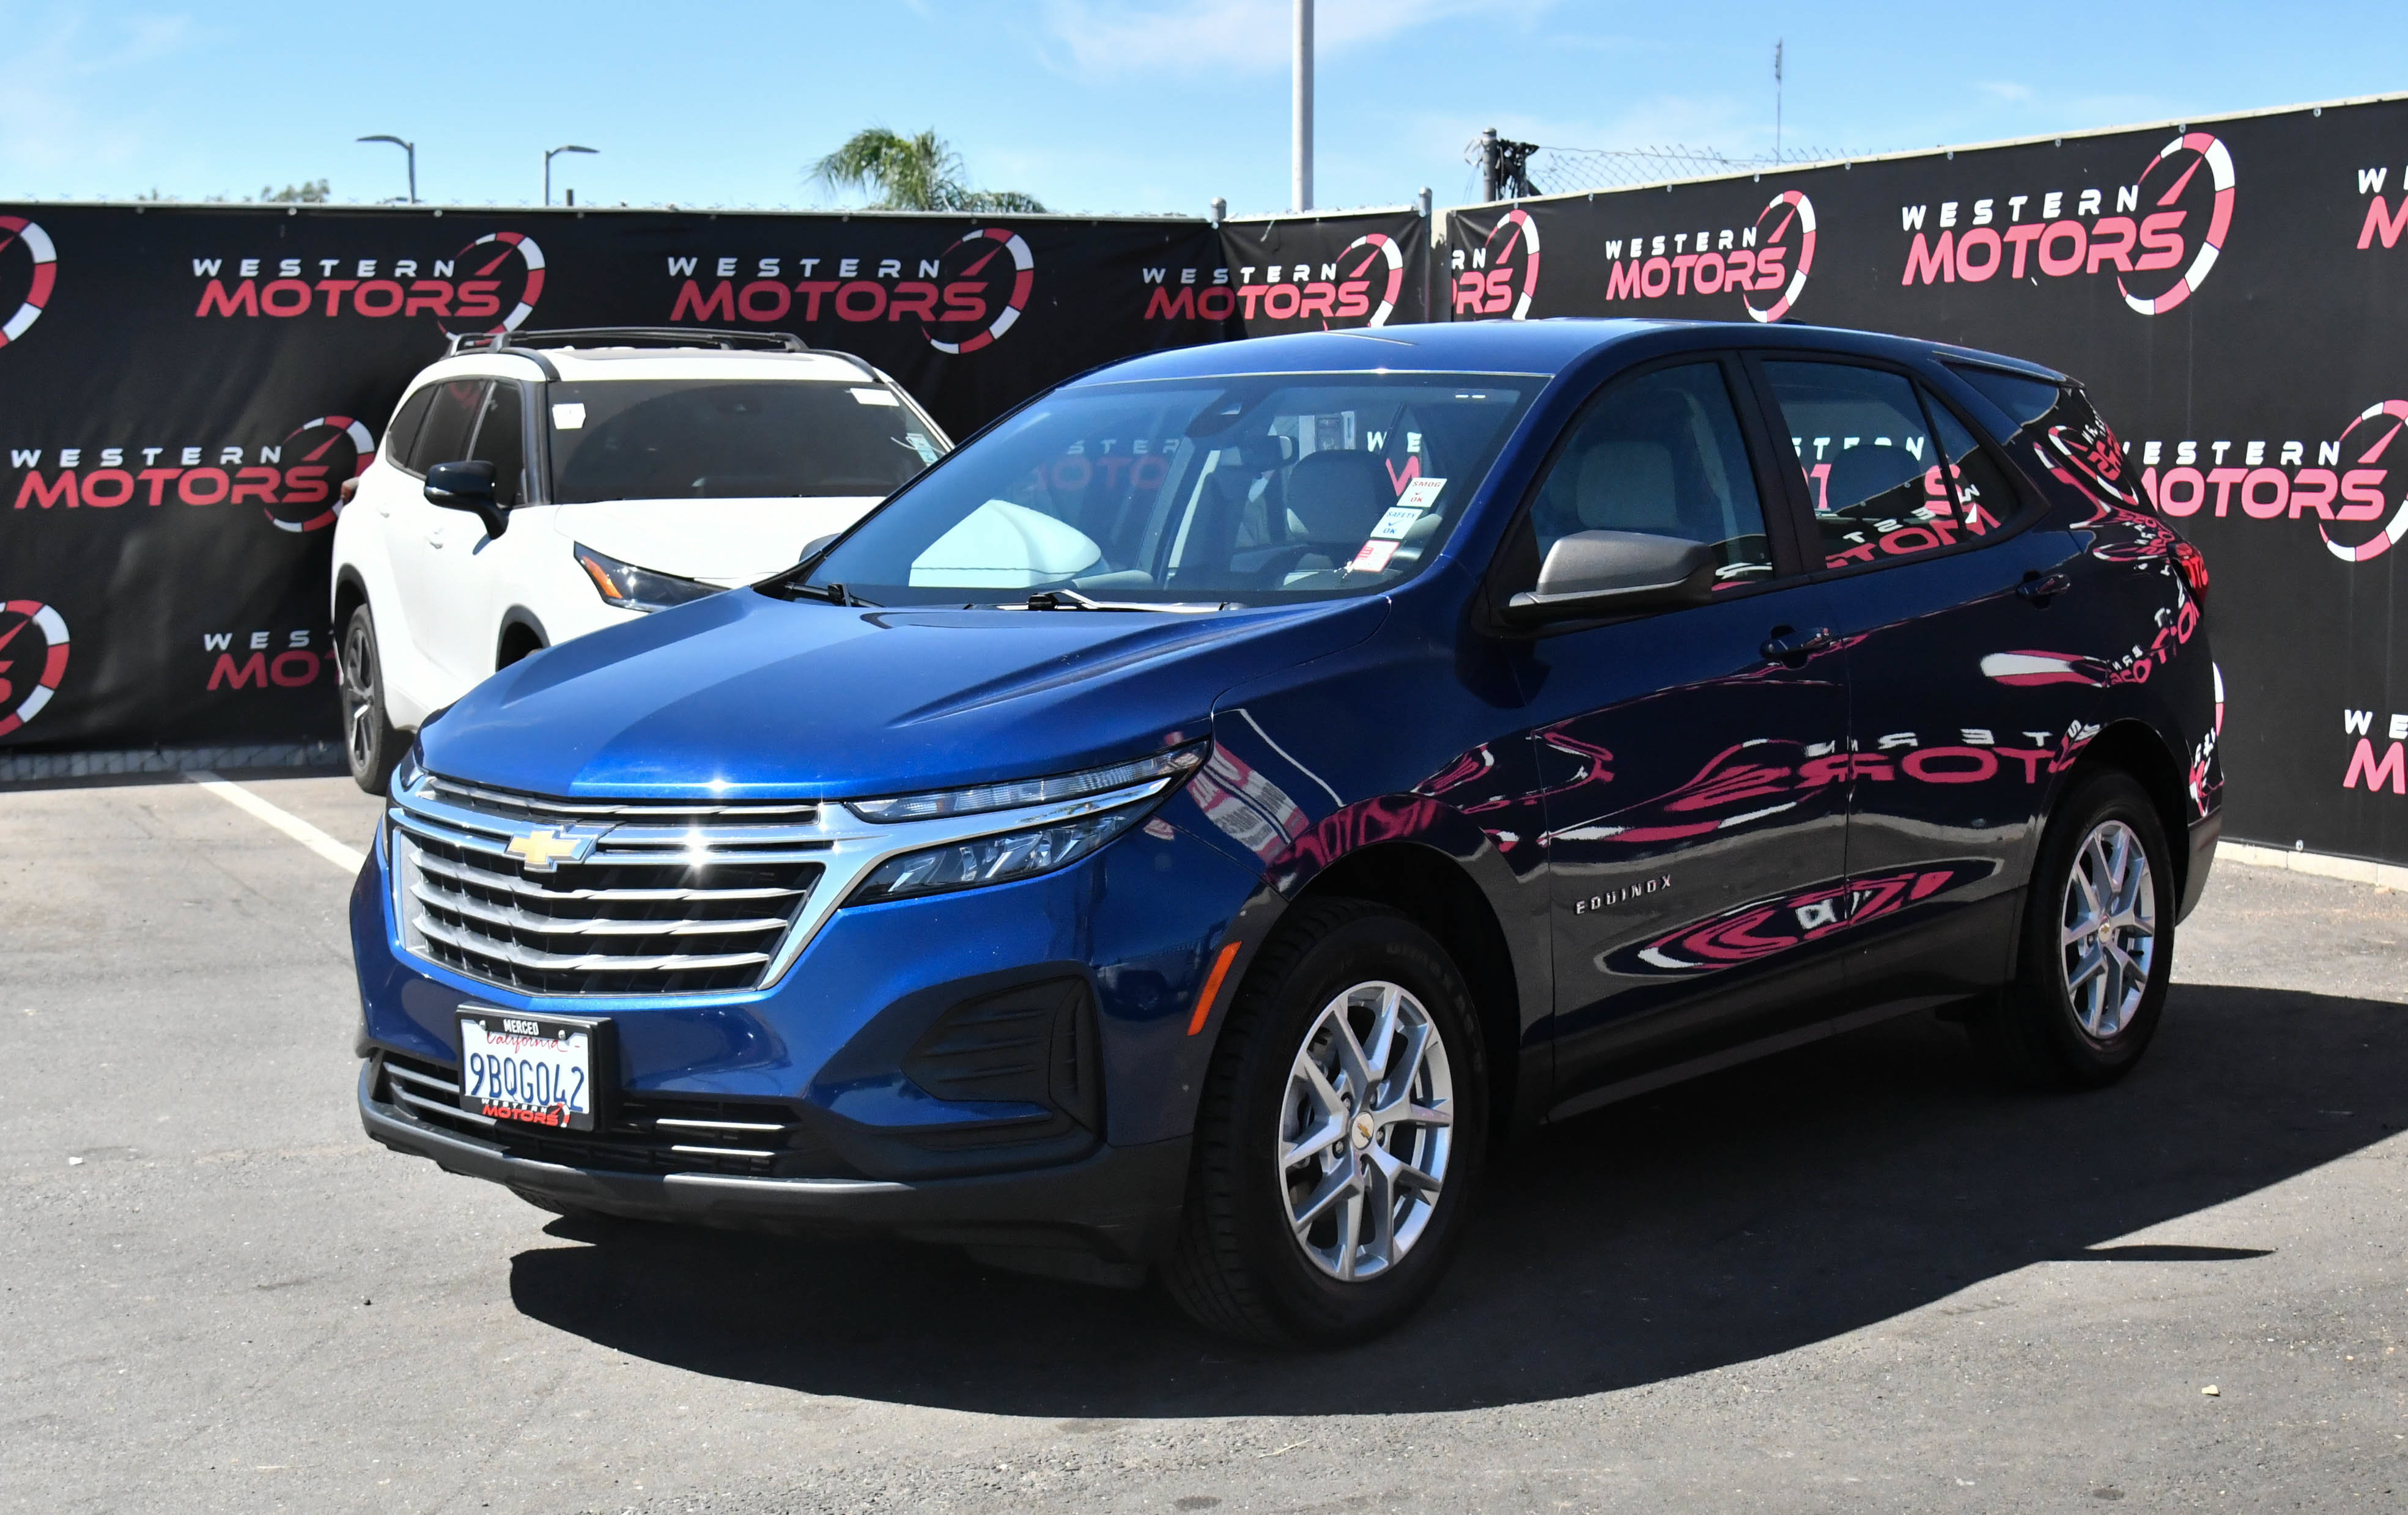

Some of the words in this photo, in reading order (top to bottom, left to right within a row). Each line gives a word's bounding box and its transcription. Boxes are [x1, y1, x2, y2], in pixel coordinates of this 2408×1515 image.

[1902, 185, 2140, 232] WESTERN
[1605, 226, 1757, 260] WESTERN
[1901, 210, 2188, 286] MOTORS
[193, 259, 455, 277] WESTERN
[668, 257, 940, 278] WESTERN
[1142, 263, 1337, 284] WESTERN
[1605, 246, 1787, 301] MOTORS
[196, 279, 501, 317] MOTORS
[670, 279, 988, 322] MOTORS
[1145, 280, 1371, 320] MOTORS
[1452, 267, 1513, 315] RS
[10, 446, 282, 468] WESTERN
[2122, 441, 2341, 466] ESTERN
[13, 466, 330, 510] MOTORS
[1387, 511, 1416, 519] SAFETY
[203, 630, 311, 652] WES
[1575, 874, 1671, 915] EQUINOX
[487, 1031, 568, 1054] California
[503, 1019, 539, 1036] MERCED
[470, 1052, 585, 1113] 9BQG042
[482, 1105, 558, 1127] MOTORS
